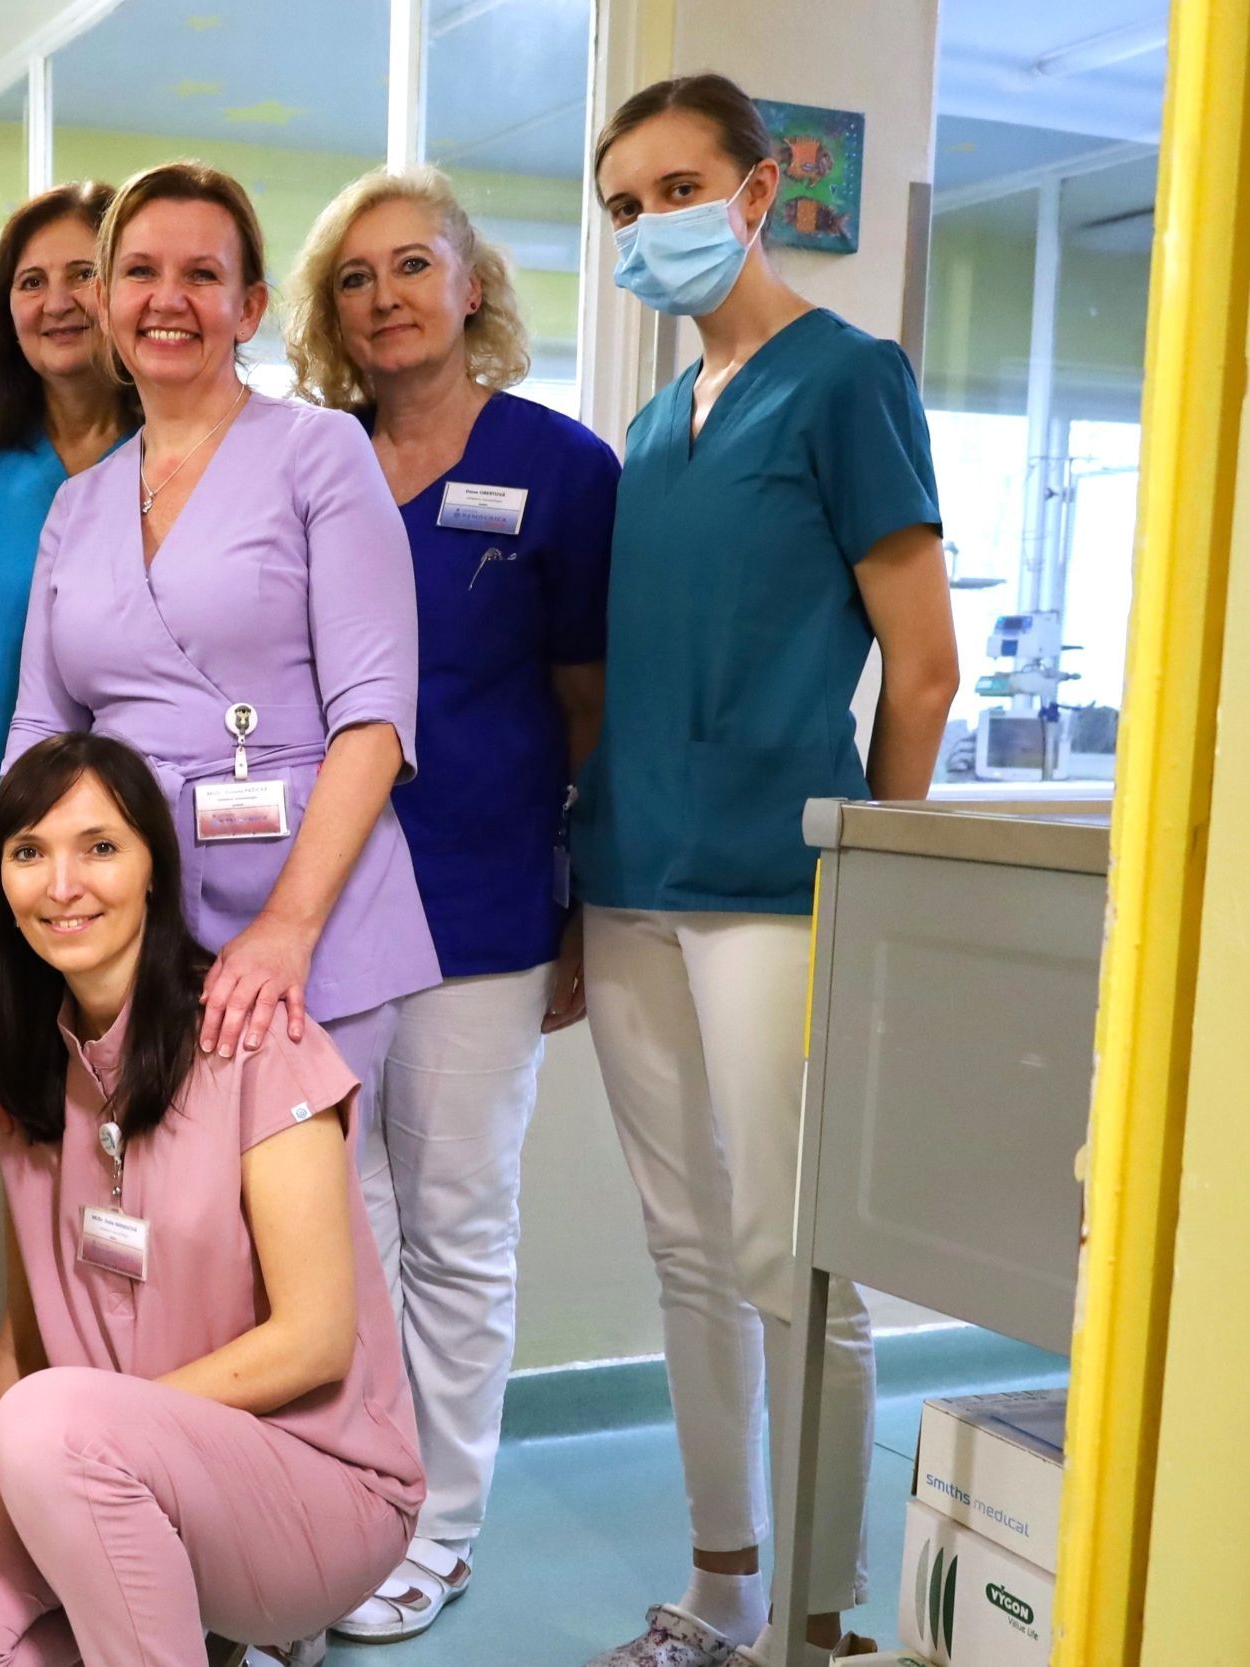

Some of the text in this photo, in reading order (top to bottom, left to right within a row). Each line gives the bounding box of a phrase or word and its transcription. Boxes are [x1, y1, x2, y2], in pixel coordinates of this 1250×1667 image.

[926, 1474, 1030, 1538] smiths medical
[991, 1587, 1029, 1620] VYGON
[1007, 1615, 1026, 1634] Value
